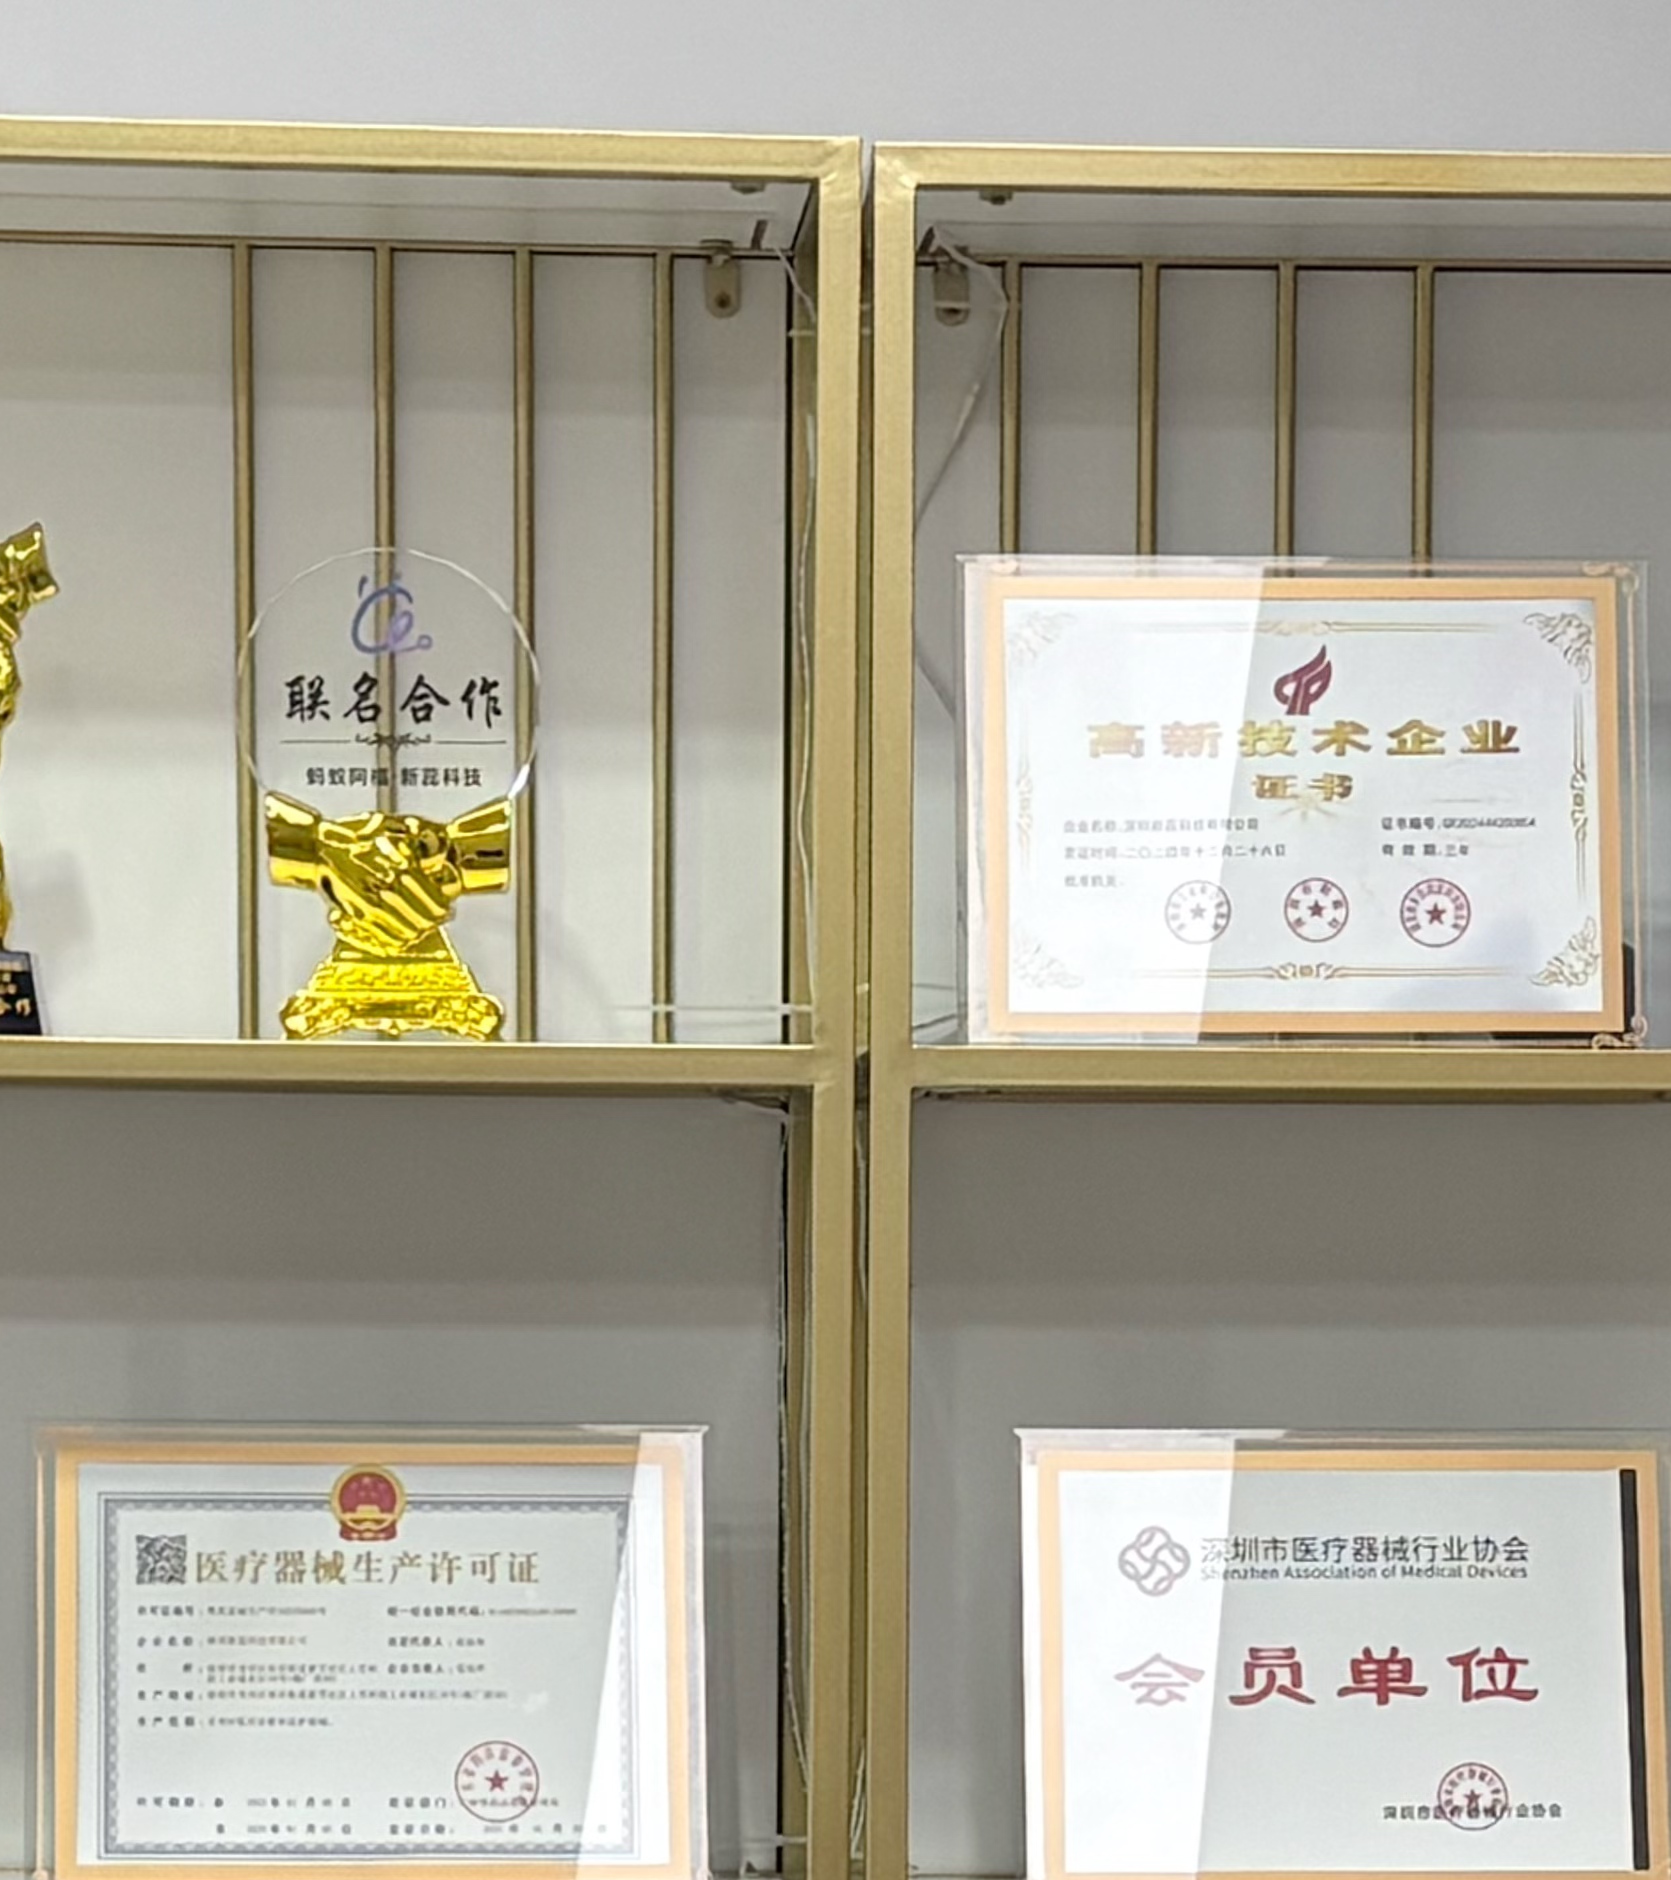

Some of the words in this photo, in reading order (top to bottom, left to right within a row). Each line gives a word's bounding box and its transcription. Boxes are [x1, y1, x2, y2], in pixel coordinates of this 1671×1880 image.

[285, 672, 502, 728] 联名合作
[1086, 720, 1520, 759] 高新技术企业
[1251, 773, 1353, 802] 证书
[194, 1547, 541, 1587] 医疗器械生产许可证
[1201, 1535, 1528, 1564] 深圳市医疗器械行业协会
[1284, 1565, 1377, 1580] Association
[1381, 1565, 1397, 1580] of
[1401, 1565, 1462, 1580] Medical
[1467, 1565, 1527, 1580] Devices
[1114, 1646, 1539, 1707] 会员单位
